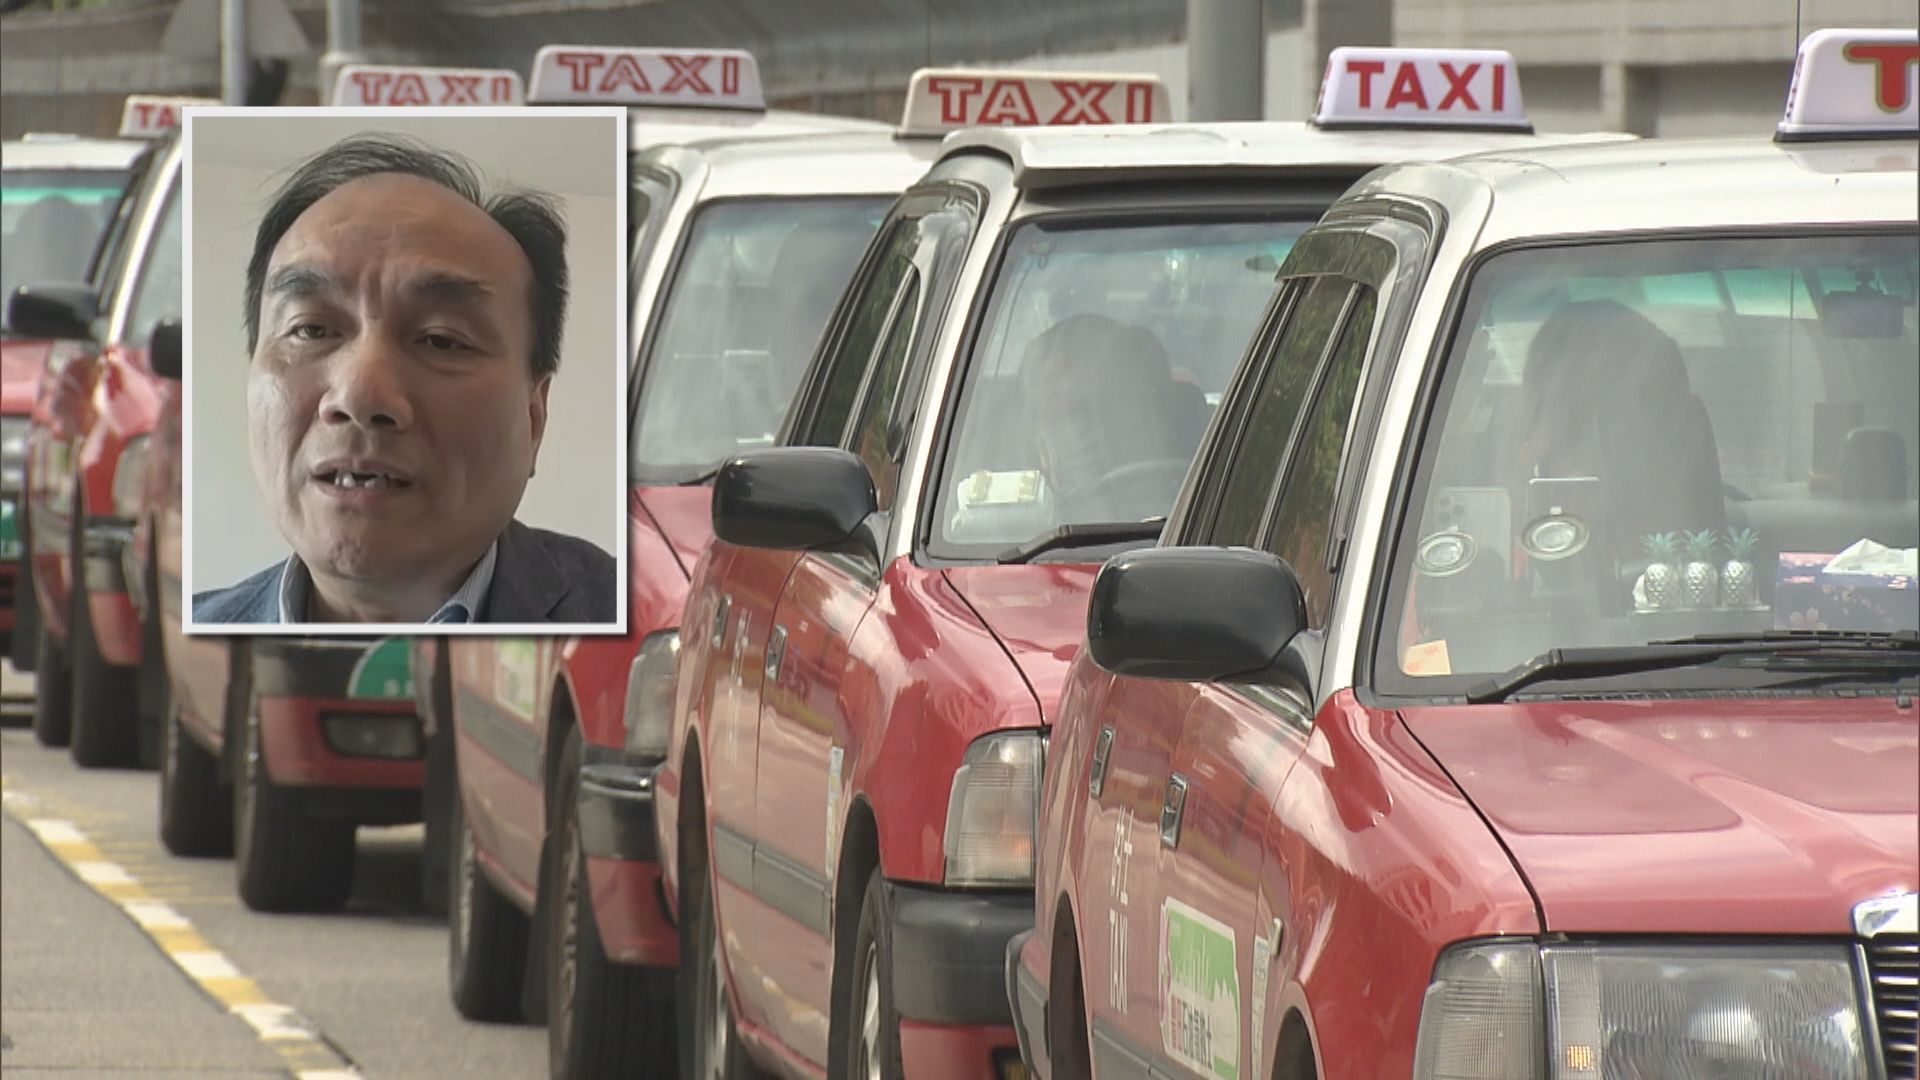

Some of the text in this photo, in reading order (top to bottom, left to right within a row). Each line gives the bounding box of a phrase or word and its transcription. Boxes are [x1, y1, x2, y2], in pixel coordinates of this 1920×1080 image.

[351, 72, 511, 106] TAXI
[556, 52, 740, 96] TAXI
[1345, 60, 1505, 112] TAXI
[927, 76, 1153, 126] TAXI
[1109, 908, 1128, 1015] TAXI
